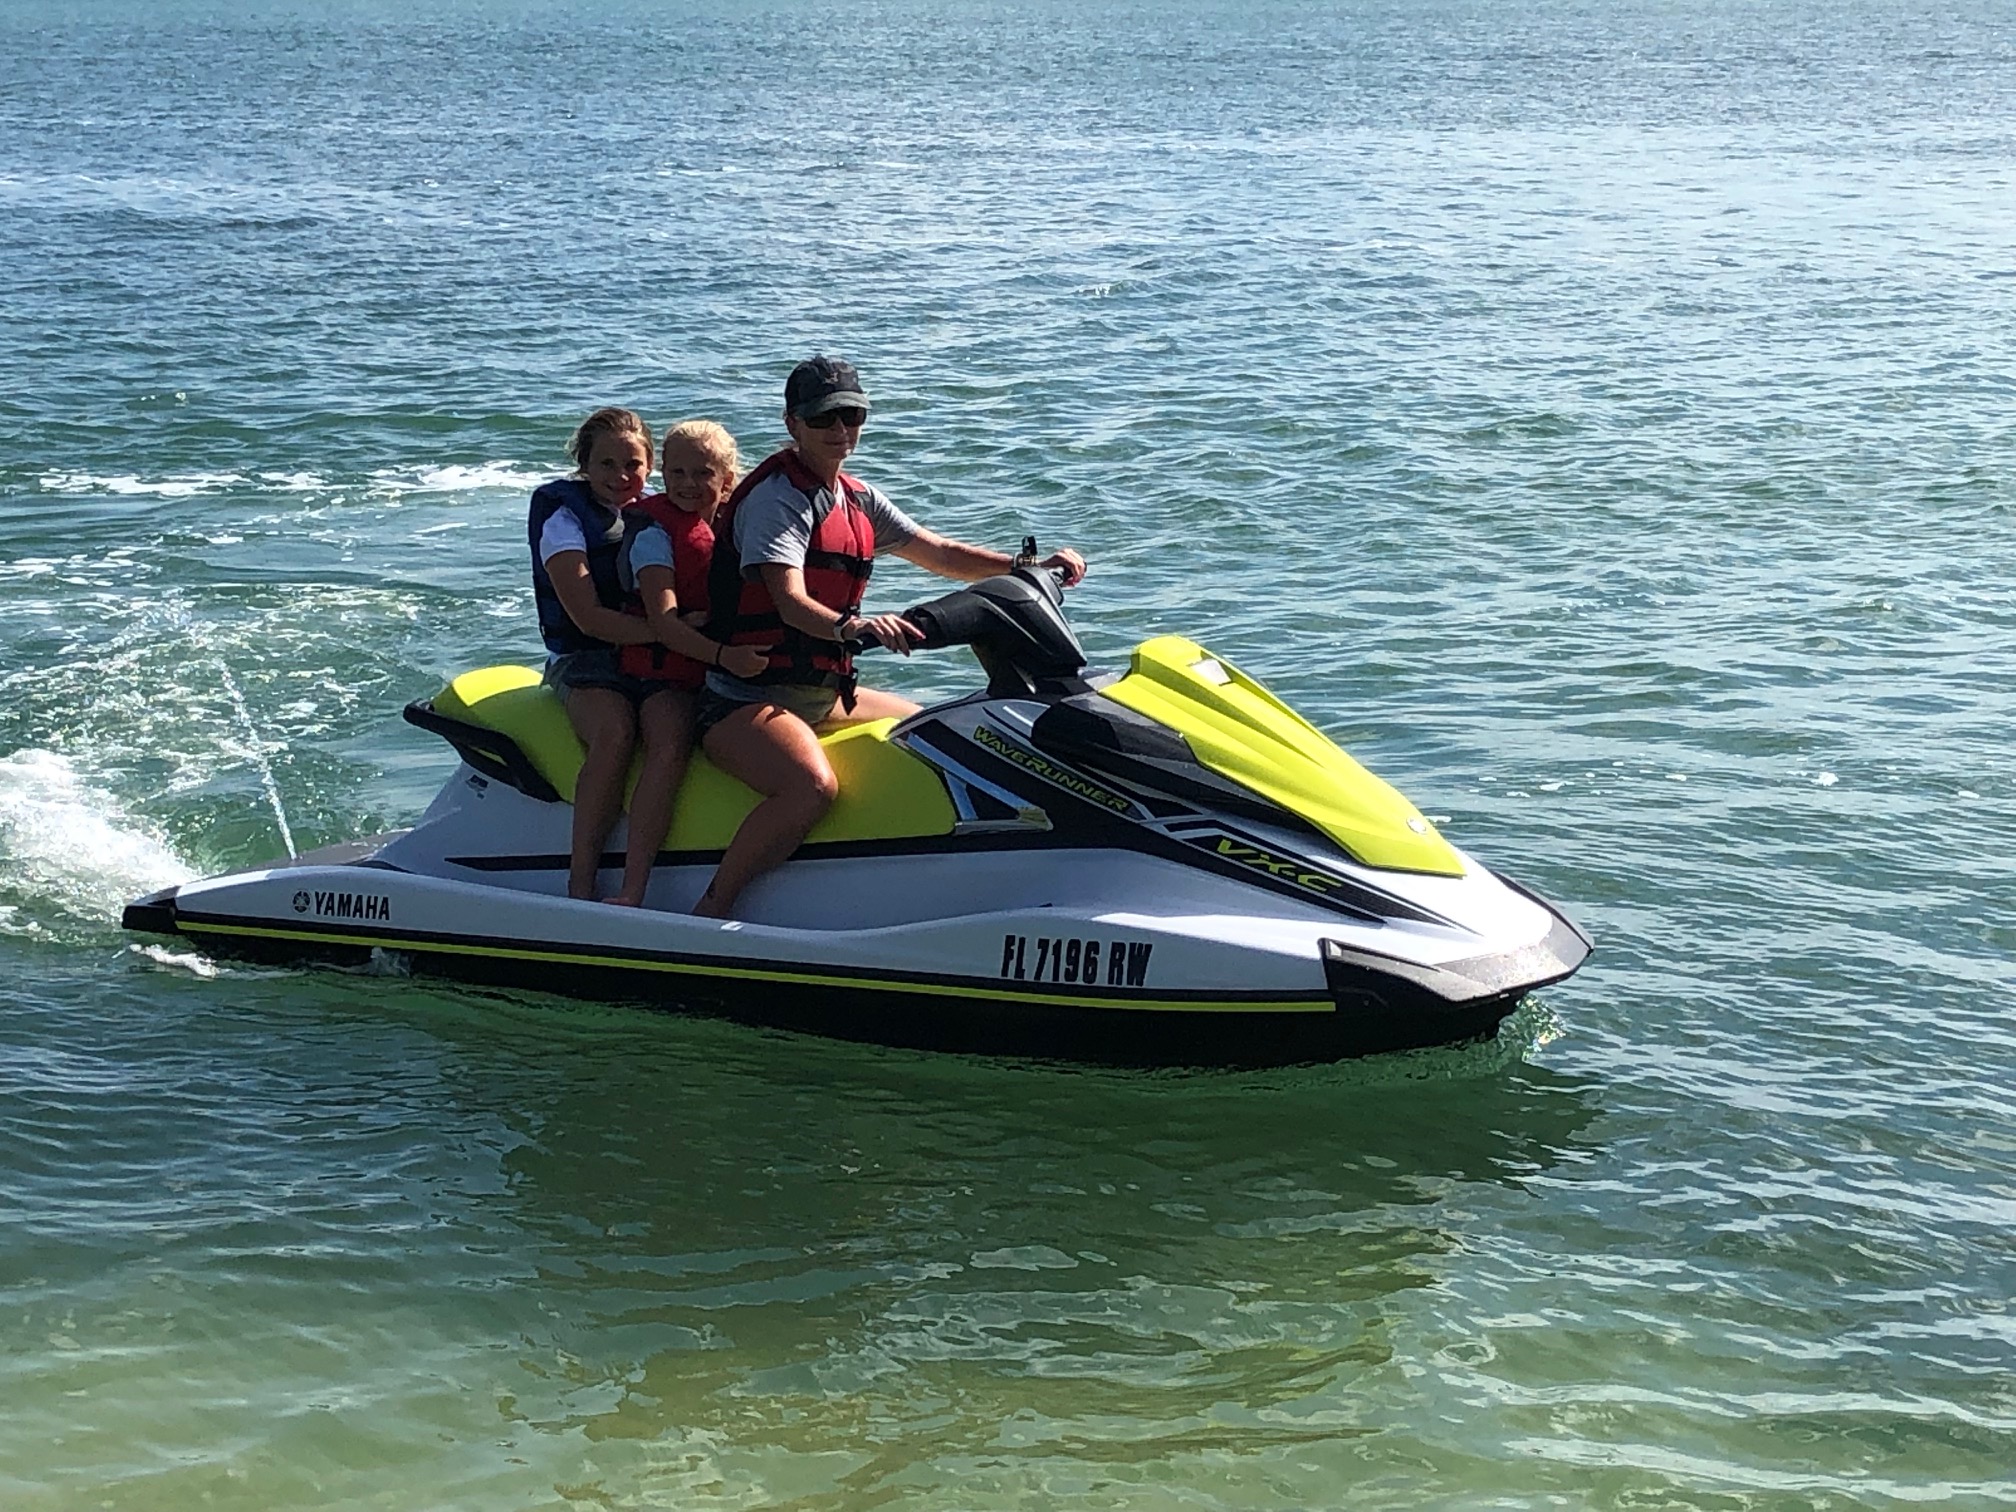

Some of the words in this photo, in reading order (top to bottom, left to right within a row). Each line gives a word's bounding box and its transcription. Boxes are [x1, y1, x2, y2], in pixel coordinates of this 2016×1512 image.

[973, 725, 1129, 811] WAVERUNNER
[1217, 839, 1342, 892] VX-C
[314, 891, 390, 920] YAMAHA
[1001, 934, 1026, 980] FL
[1034, 938, 1100, 984] 7196
[1108, 941, 1153, 987] RW
